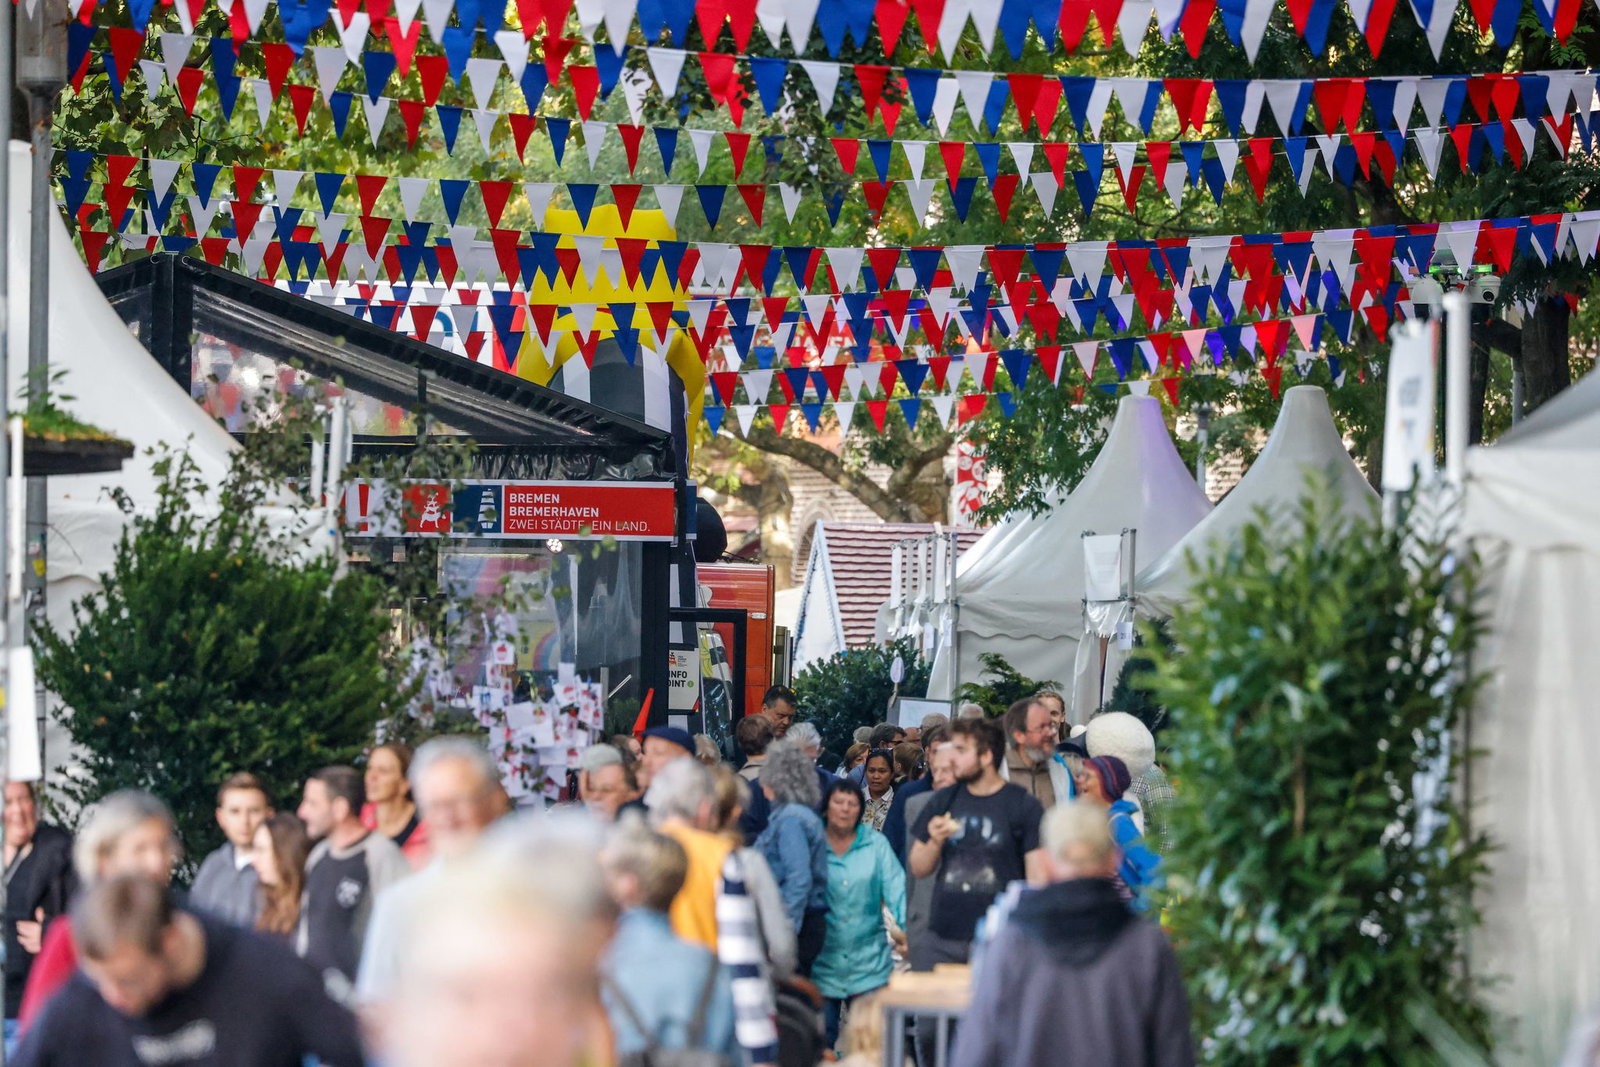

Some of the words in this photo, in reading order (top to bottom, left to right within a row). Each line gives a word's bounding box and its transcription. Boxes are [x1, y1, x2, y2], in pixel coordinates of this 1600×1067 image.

[509, 493, 560, 504] BREMEN
[509, 506, 599, 517] BREMERHAVEN
[509, 519, 538, 530] ZWEI
[592, 520, 612, 531] EIN
[615, 521, 651, 532] LAND.
